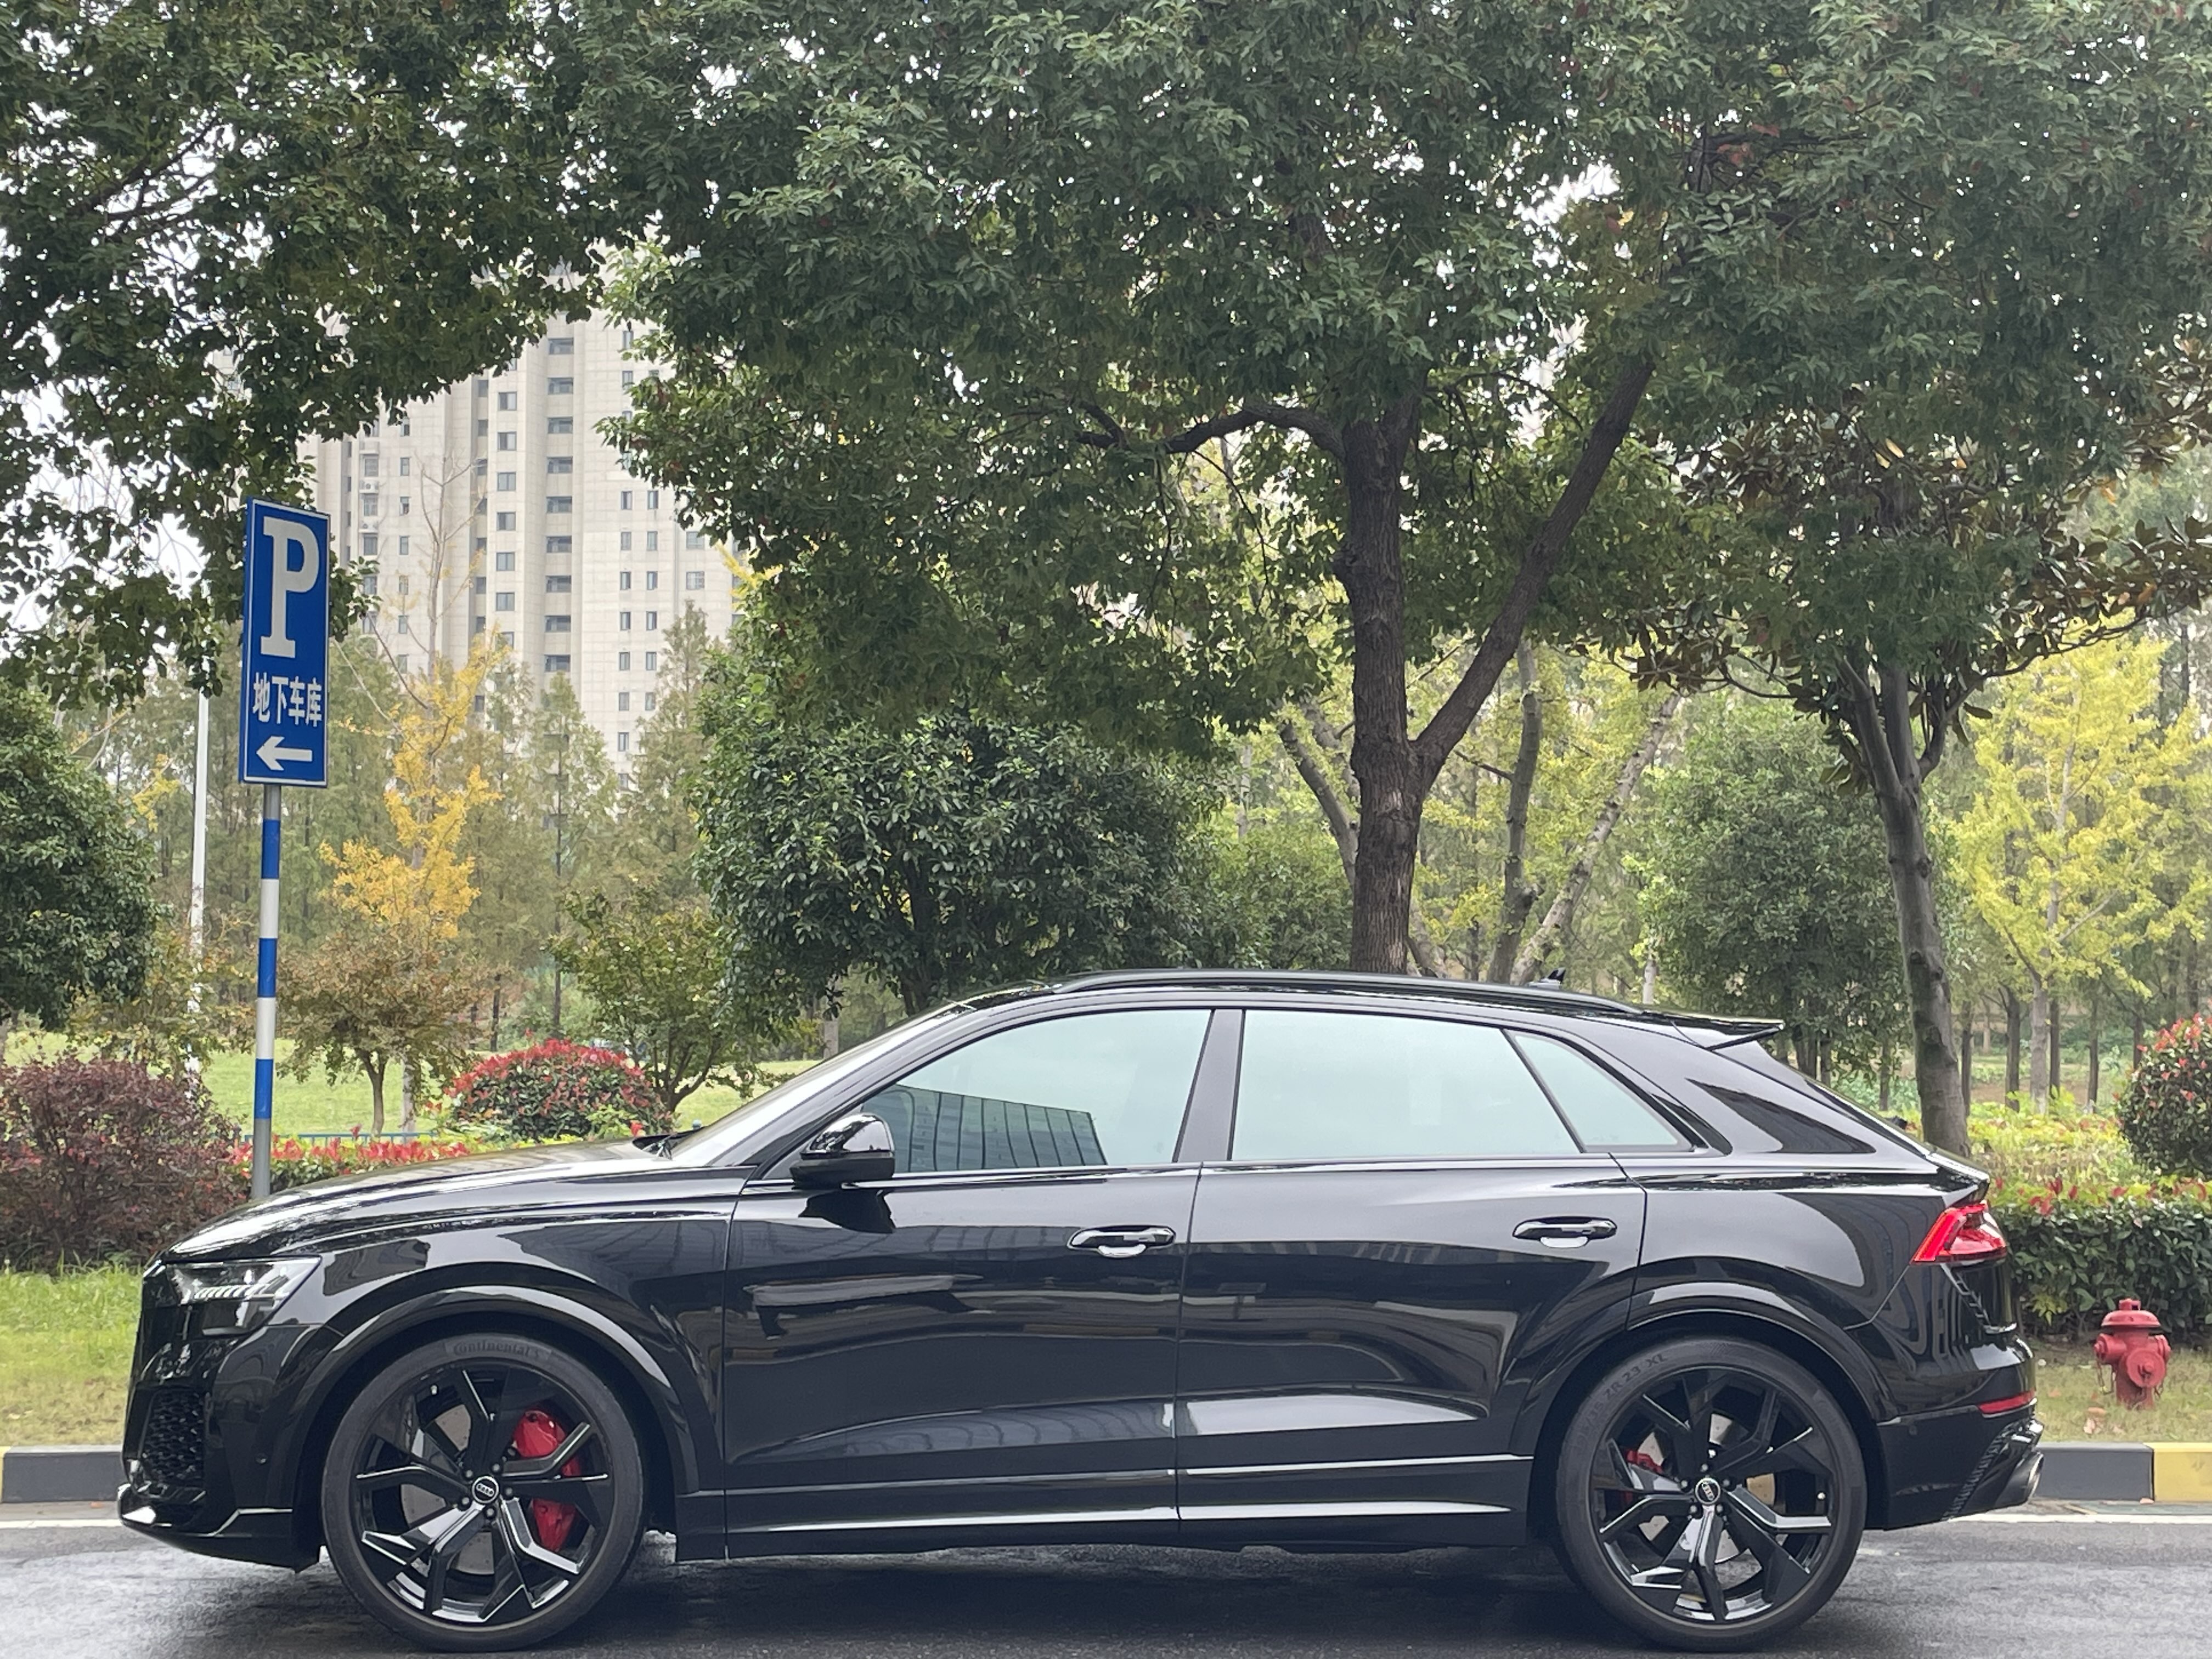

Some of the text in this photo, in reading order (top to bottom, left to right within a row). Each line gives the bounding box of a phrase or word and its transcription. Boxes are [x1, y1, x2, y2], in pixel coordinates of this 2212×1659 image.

[261, 516, 320, 658] P
[252, 672, 323, 727] 地下车库
[453, 1339, 531, 1357] Continental
[1645, 1353, 1668, 1368] XL
